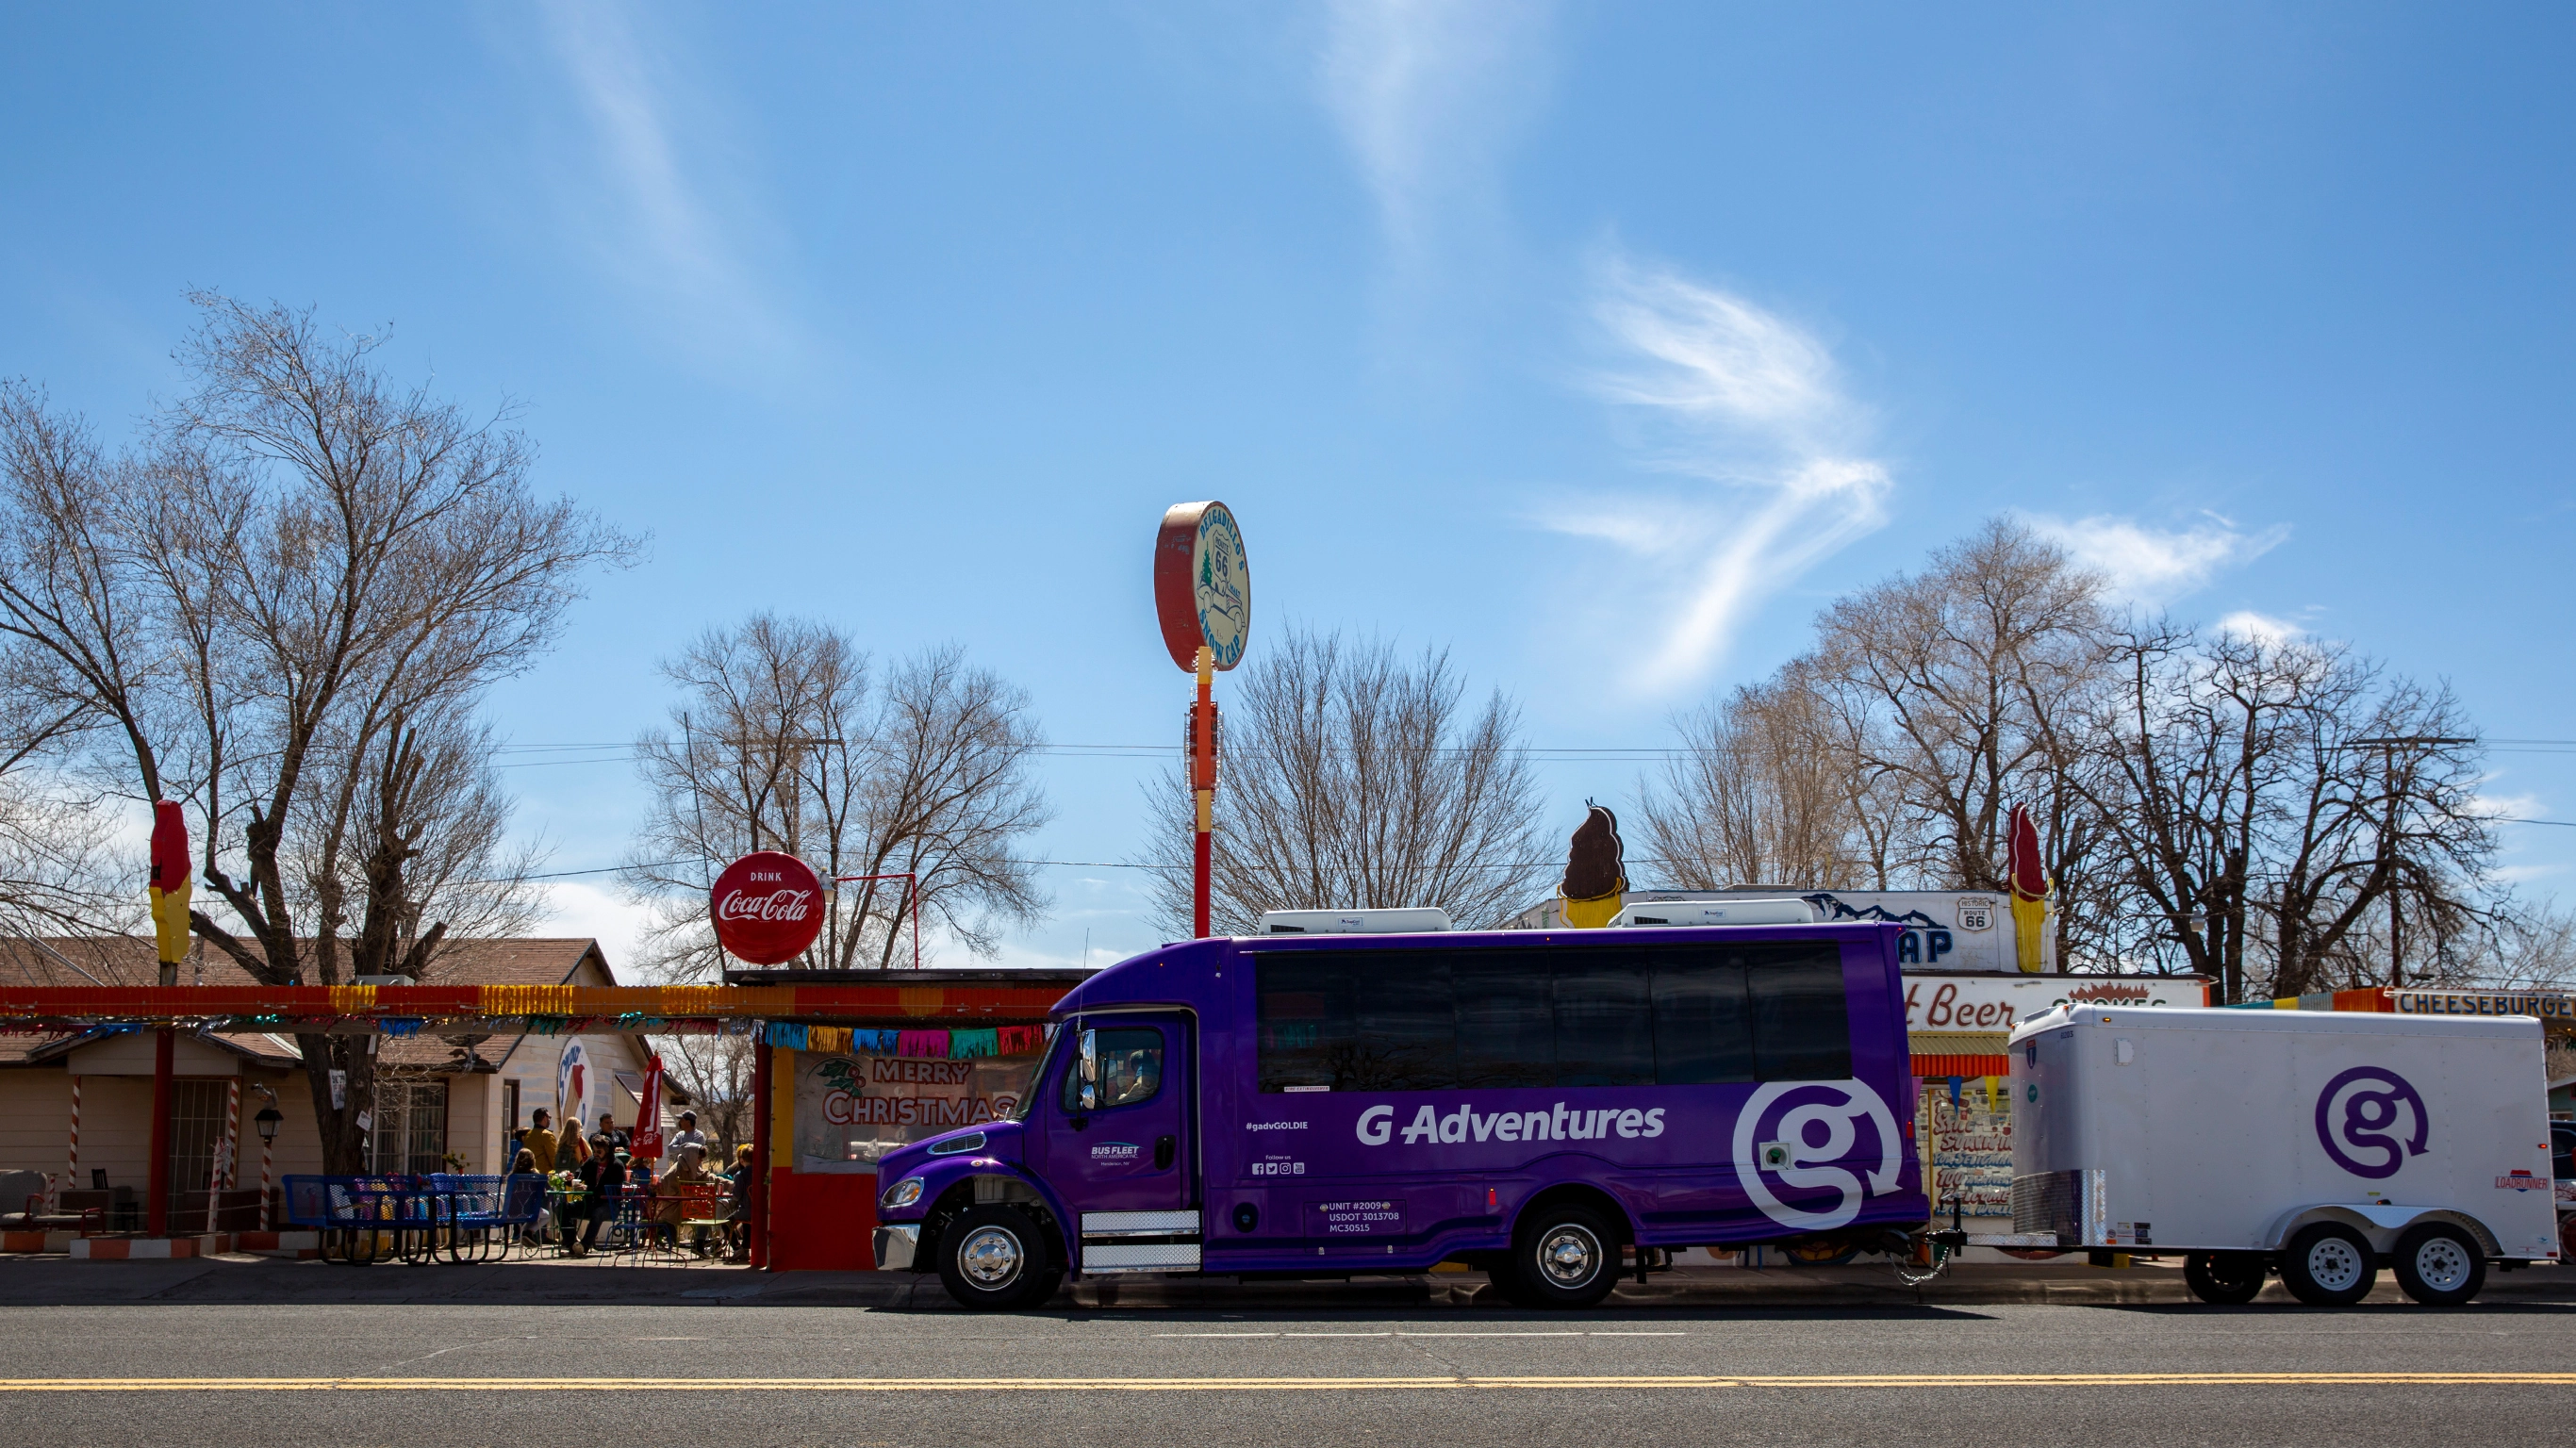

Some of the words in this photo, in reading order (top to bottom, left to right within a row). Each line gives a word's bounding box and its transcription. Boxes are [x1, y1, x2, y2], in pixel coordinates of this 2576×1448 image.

[1199, 509, 1245, 571] DELGADILLO'S
[1215, 535, 1230, 553] ROUTE
[1215, 551, 1229, 578] 66
[1199, 608, 1224, 663] SNOW
[1226, 634, 1241, 664] CAP
[751, 872, 782, 881] DRINK
[718, 889, 813, 921] Coca-Cola
[1966, 915, 1985, 928] 66
[1926, 983, 2014, 1027] Beer
[2399, 994, 2576, 1019] CHEESEBURGE
[873, 1059, 971, 1084] MERRY
[822, 1089, 1017, 1127] CHRISTMAS
[1246, 1122, 1308, 1131] #gadvGOLDIE
[1356, 1105, 1394, 1145] G
[1400, 1102, 1666, 1144] Adventures
[1091, 1146, 1111, 1155] BUS
[1111, 1146, 1139, 1155] FLEET
[2495, 1177, 2548, 1189] LOADRUNNER
[1329, 1202, 1350, 1210] UNIT
[1353, 1202, 1381, 1210] #2009
[1329, 1213, 1360, 1222] USDOT
[1362, 1212, 1399, 1221] 3013708
[1329, 1224, 1370, 1232] MC30515
